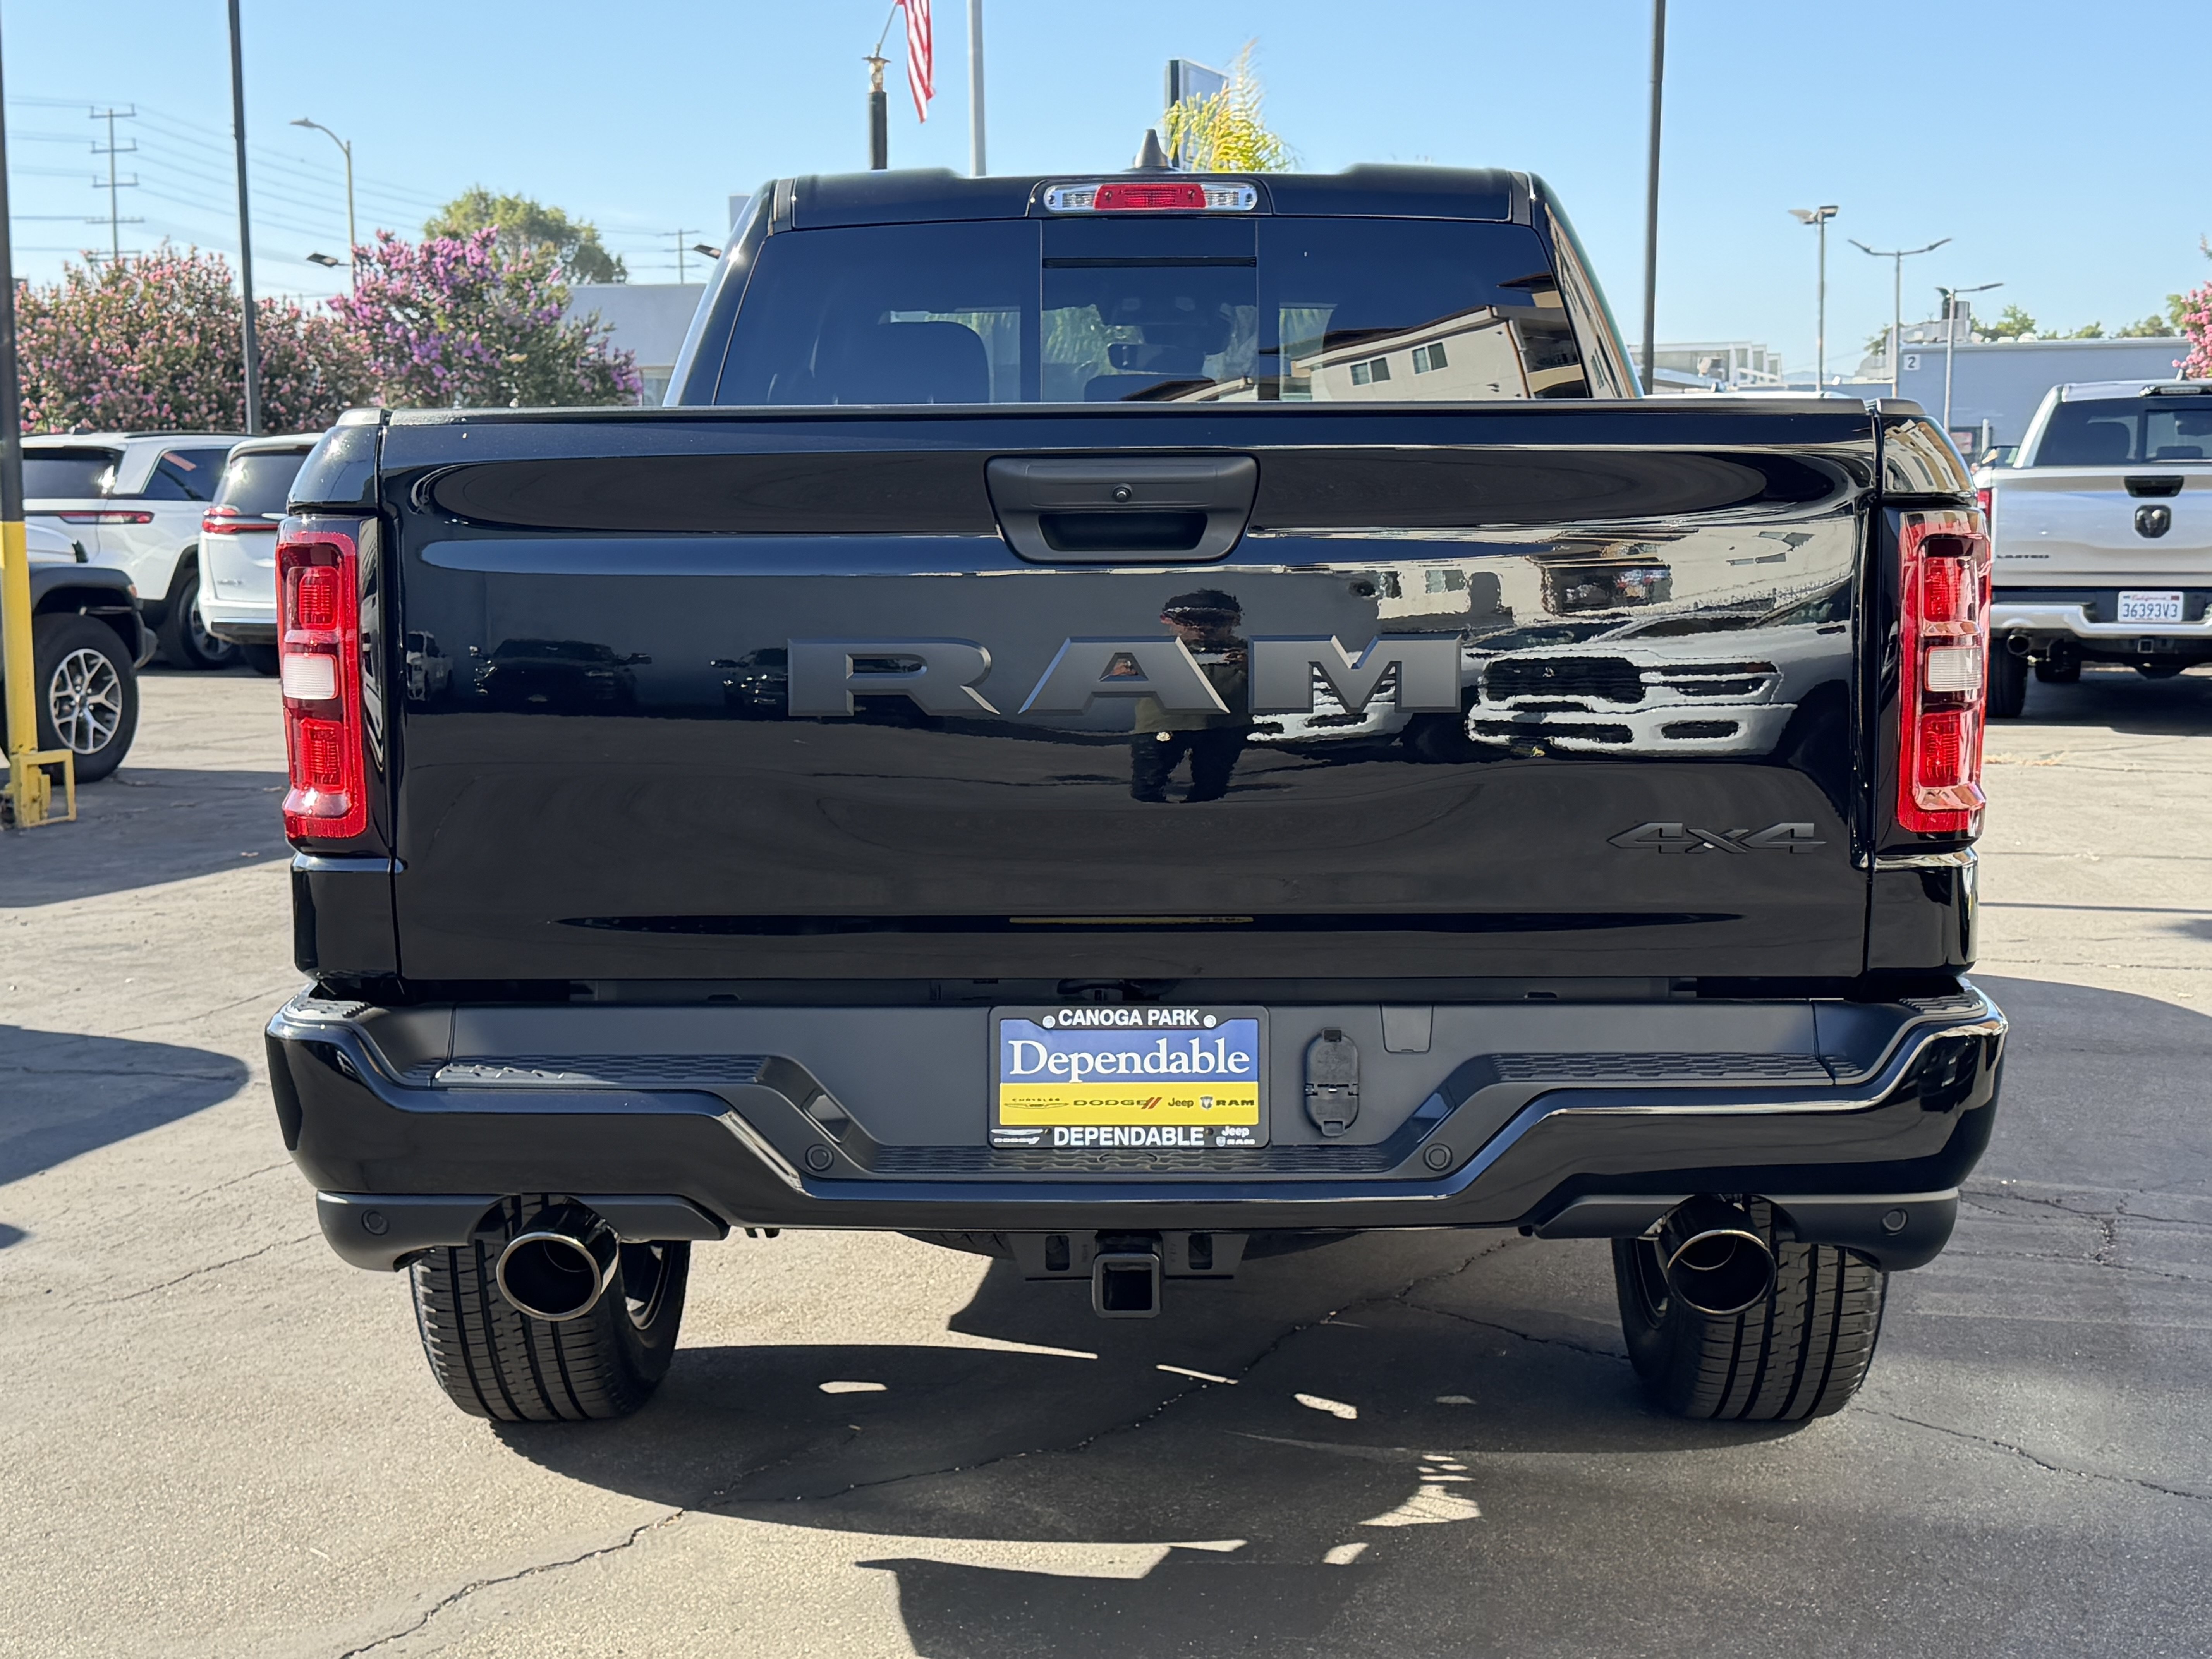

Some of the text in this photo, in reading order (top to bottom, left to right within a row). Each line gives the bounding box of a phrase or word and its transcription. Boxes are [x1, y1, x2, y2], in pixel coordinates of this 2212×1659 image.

[1908, 356, 1916, 368] 2
[2123, 603, 2178, 618] 36393V3
[787, 635, 1462, 716] RAM
[1058, 1009, 1199, 1026] CANOGA PARK
[1008, 1037, 1250, 1083] Dependable
[1168, 1097, 1194, 1108] Jeep
[1054, 1127, 1204, 1146] DEPENDABLE
[1221, 1126, 1250, 1137] Jeep
